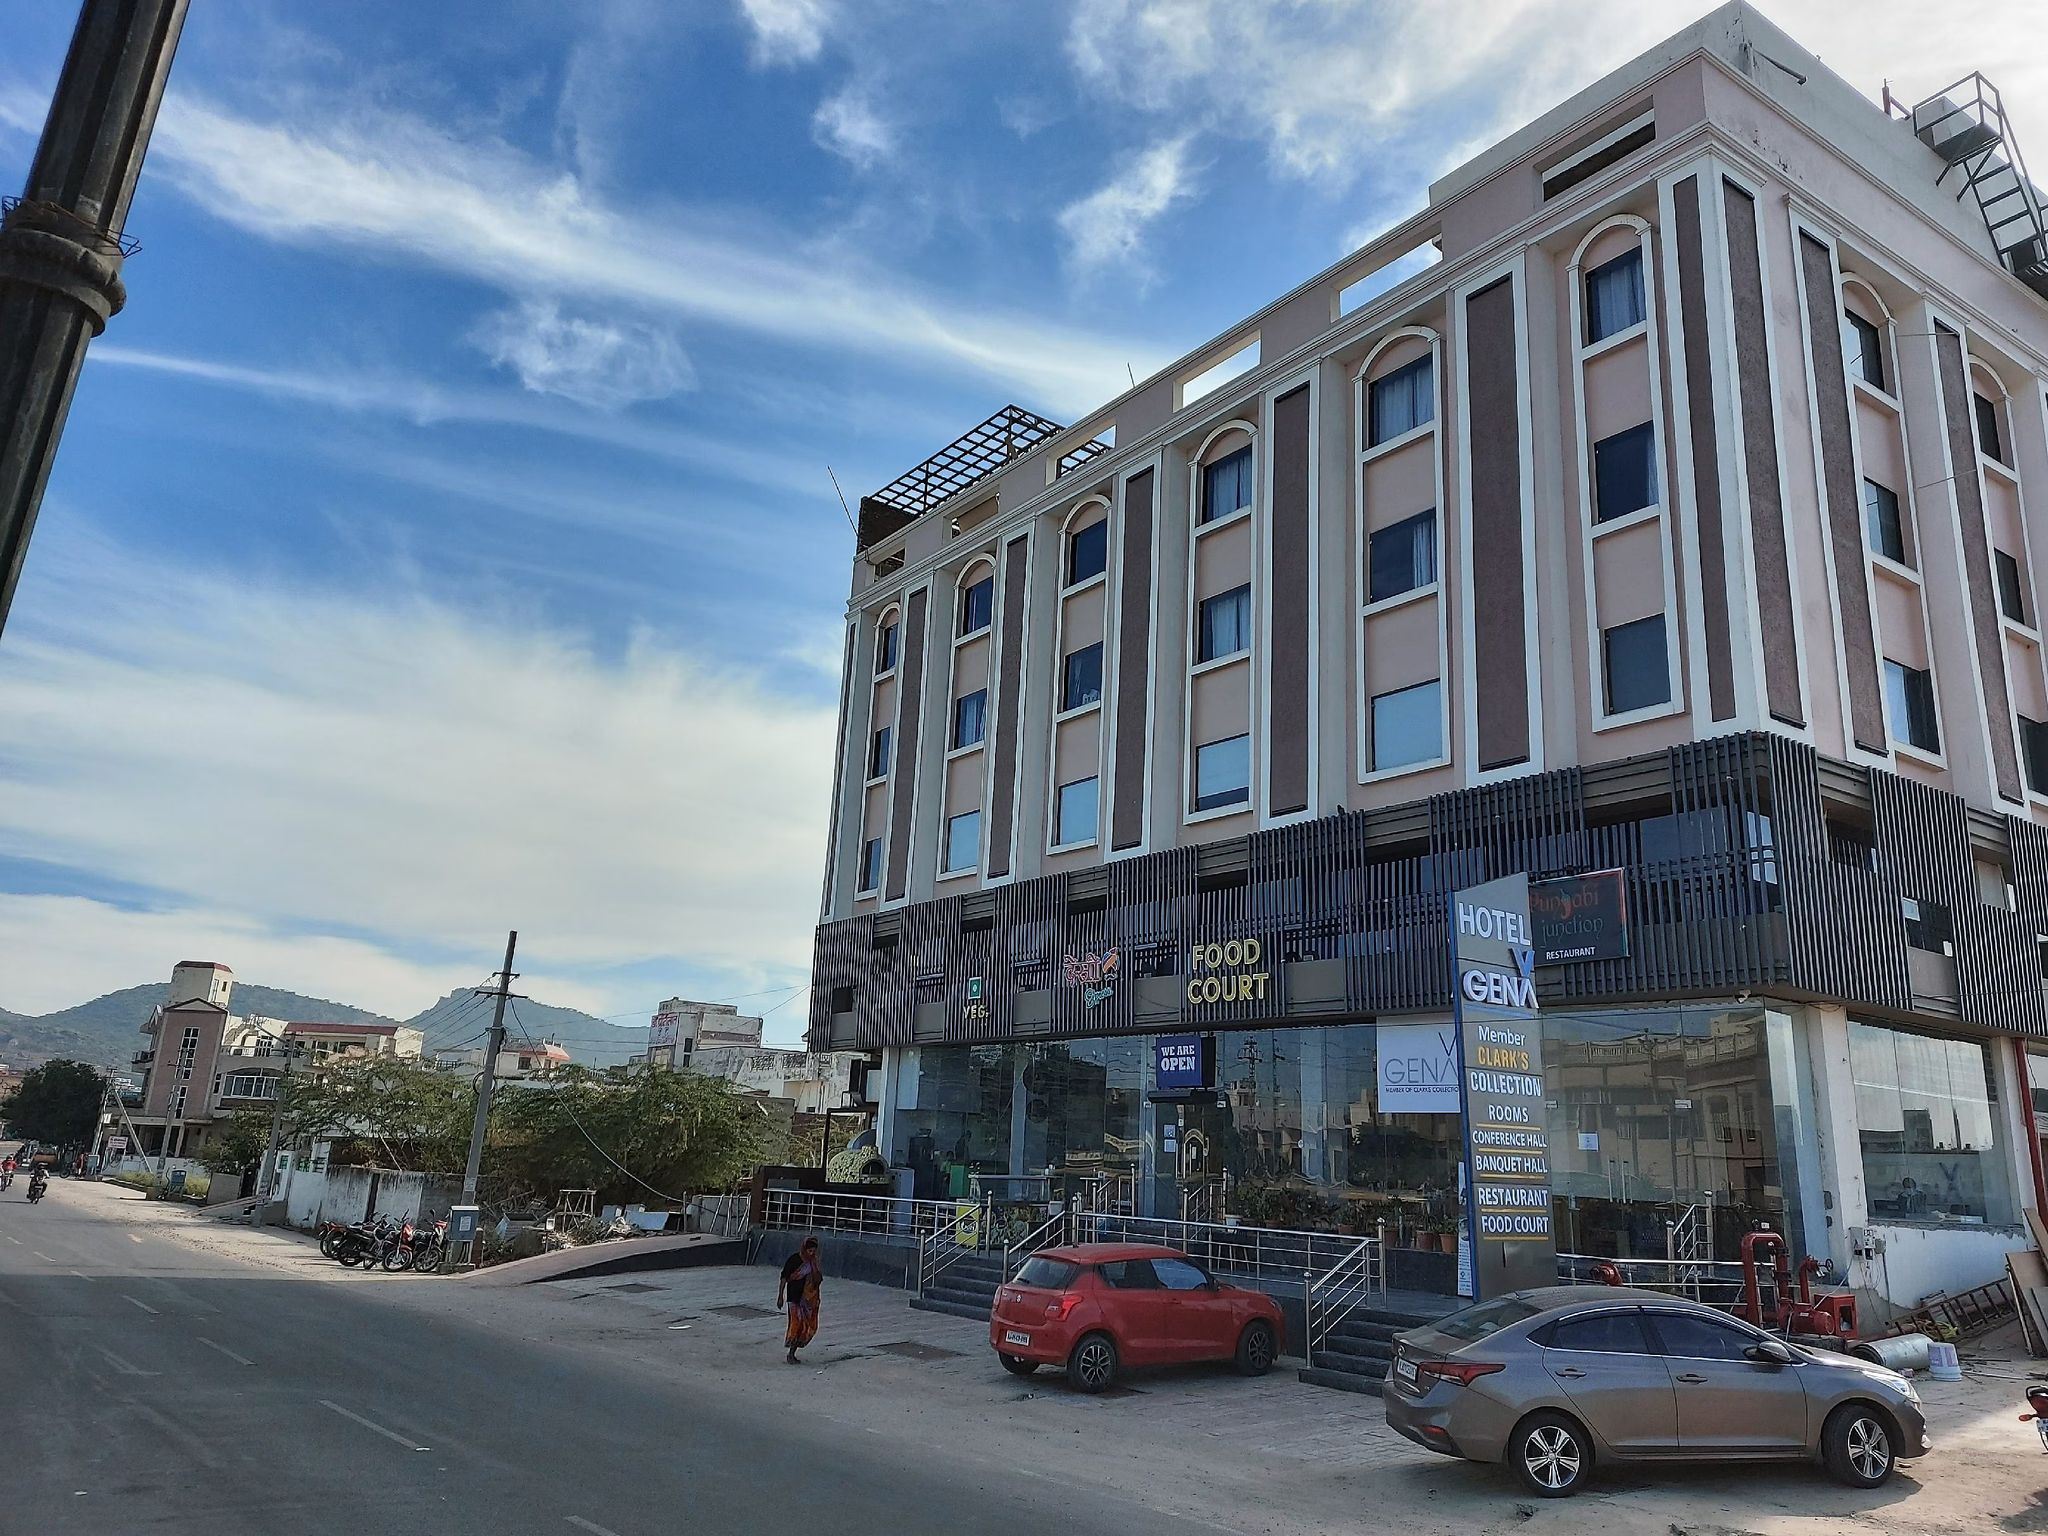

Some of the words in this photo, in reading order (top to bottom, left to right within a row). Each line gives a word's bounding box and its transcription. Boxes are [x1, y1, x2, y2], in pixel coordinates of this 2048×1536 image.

[1458, 902, 1531, 946] HOTEL
[1541, 914, 1604, 949] junction
[1192, 938, 1261, 971] FOOD
[1546, 946, 1596, 961] RESTAURANT
[1187, 972, 1269, 1004] COURT
[1478, 1025, 1526, 1046] Member
[1160, 1046, 1175, 1057] WE
[1177, 1044, 1195, 1056] ARE
[1478, 1046, 1530, 1071] CLARK'S
[1160, 1056, 1196, 1071] OPEN
[1470, 1071, 1542, 1097] COLLECTION
[1488, 1104, 1530, 1123] ROOMS
[1472, 1130, 1526, 1146] CONFERENCE
[1527, 1134, 1548, 1148] HALL
[1475, 1155, 1522, 1173] BANQUET
[1524, 1157, 1548, 1173] HALL
[1478, 1187, 1549, 1206] RESTAURANT
[1481, 1215, 1513, 1233] FOOD
[1514, 1216, 1549, 1233] COURT
